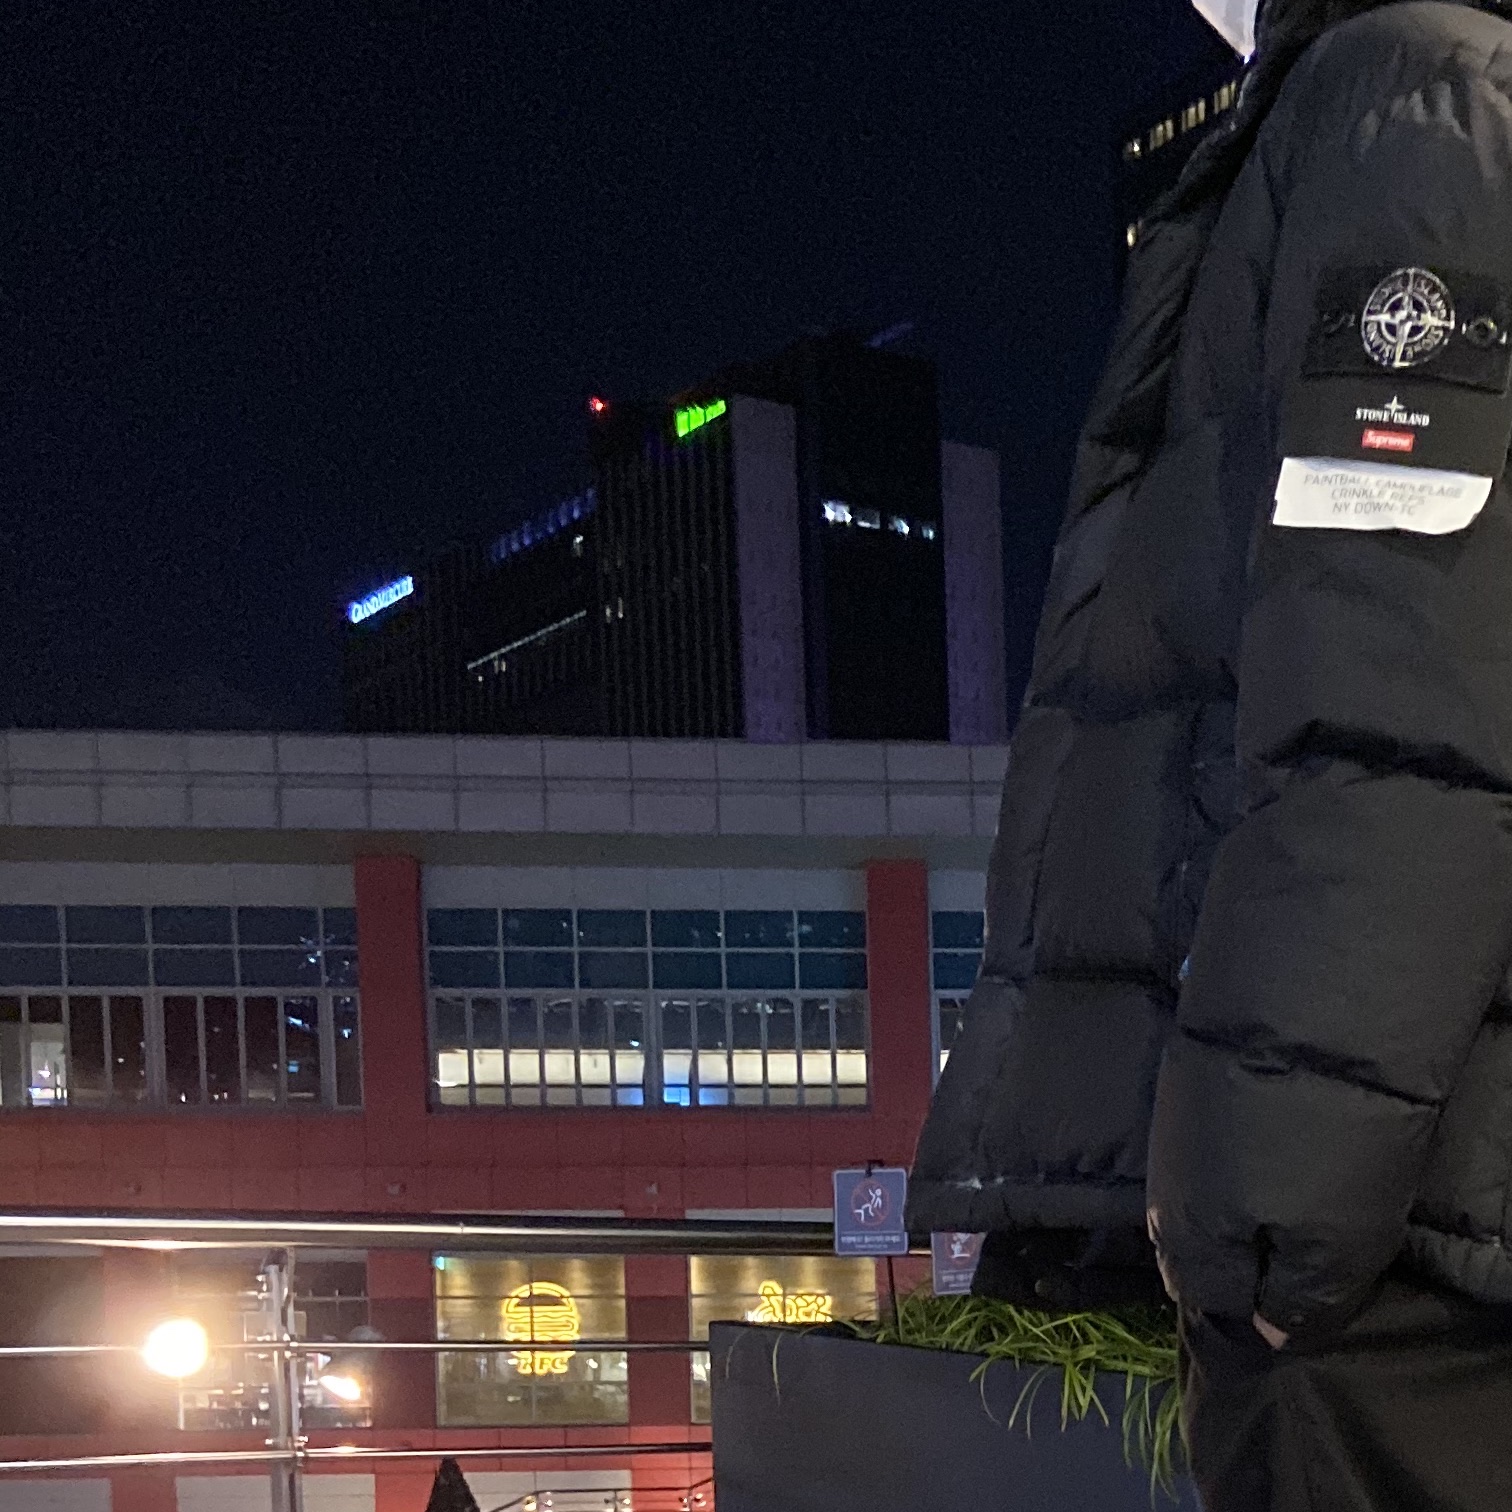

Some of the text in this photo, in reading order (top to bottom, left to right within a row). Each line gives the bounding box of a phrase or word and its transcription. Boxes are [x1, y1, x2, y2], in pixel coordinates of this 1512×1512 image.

[1355, 407, 1430, 427] STONE ISLAND
[1332, 502, 1350, 514] NY
